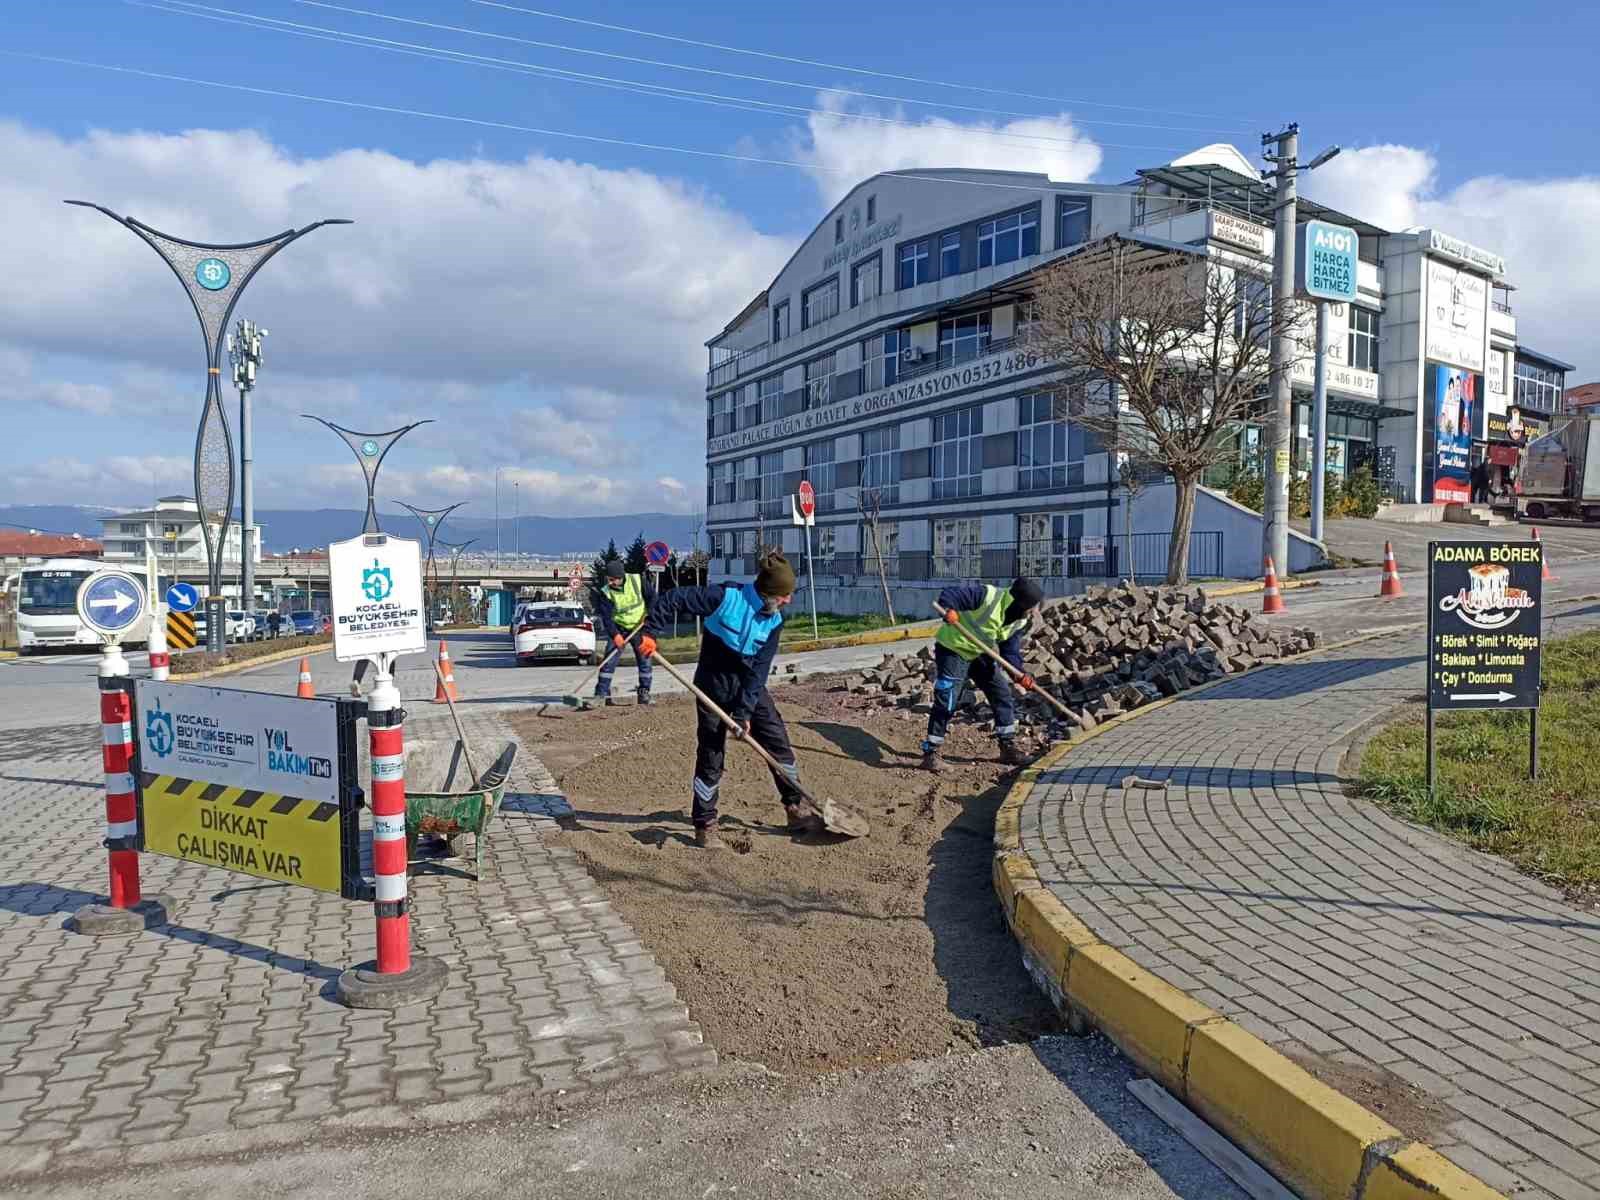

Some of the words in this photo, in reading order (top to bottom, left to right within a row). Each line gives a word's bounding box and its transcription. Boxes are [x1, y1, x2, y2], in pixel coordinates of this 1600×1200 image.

[1314, 251, 1350, 268] HARCA
[1314, 264, 1349, 281] HARCA
[816, 405, 847, 425] DAVET
[853, 401, 863, 415] &
[863, 371, 961, 412] ORGANİZASYON
[962, 359, 1000, 385] 0532
[1004, 351, 1037, 373] 486
[1434, 547, 1485, 562] ADANA
[1490, 544, 1540, 562] BÖREK
[1442, 634, 1468, 647] Börek
[1476, 634, 1499, 647] Simit
[1507, 634, 1538, 650] Poğaça
[1442, 653, 1476, 666] Baklava
[1485, 653, 1525, 666] Limonata
[1442, 672, 1459, 687] Çay
[1468, 671, 1513, 684] Dondurma
[264, 728, 293, 752] YOL
[200, 806, 268, 840] DİKKAT
[177, 832, 259, 867] ÇALIŞMA
[262, 850, 303, 879] VAR
